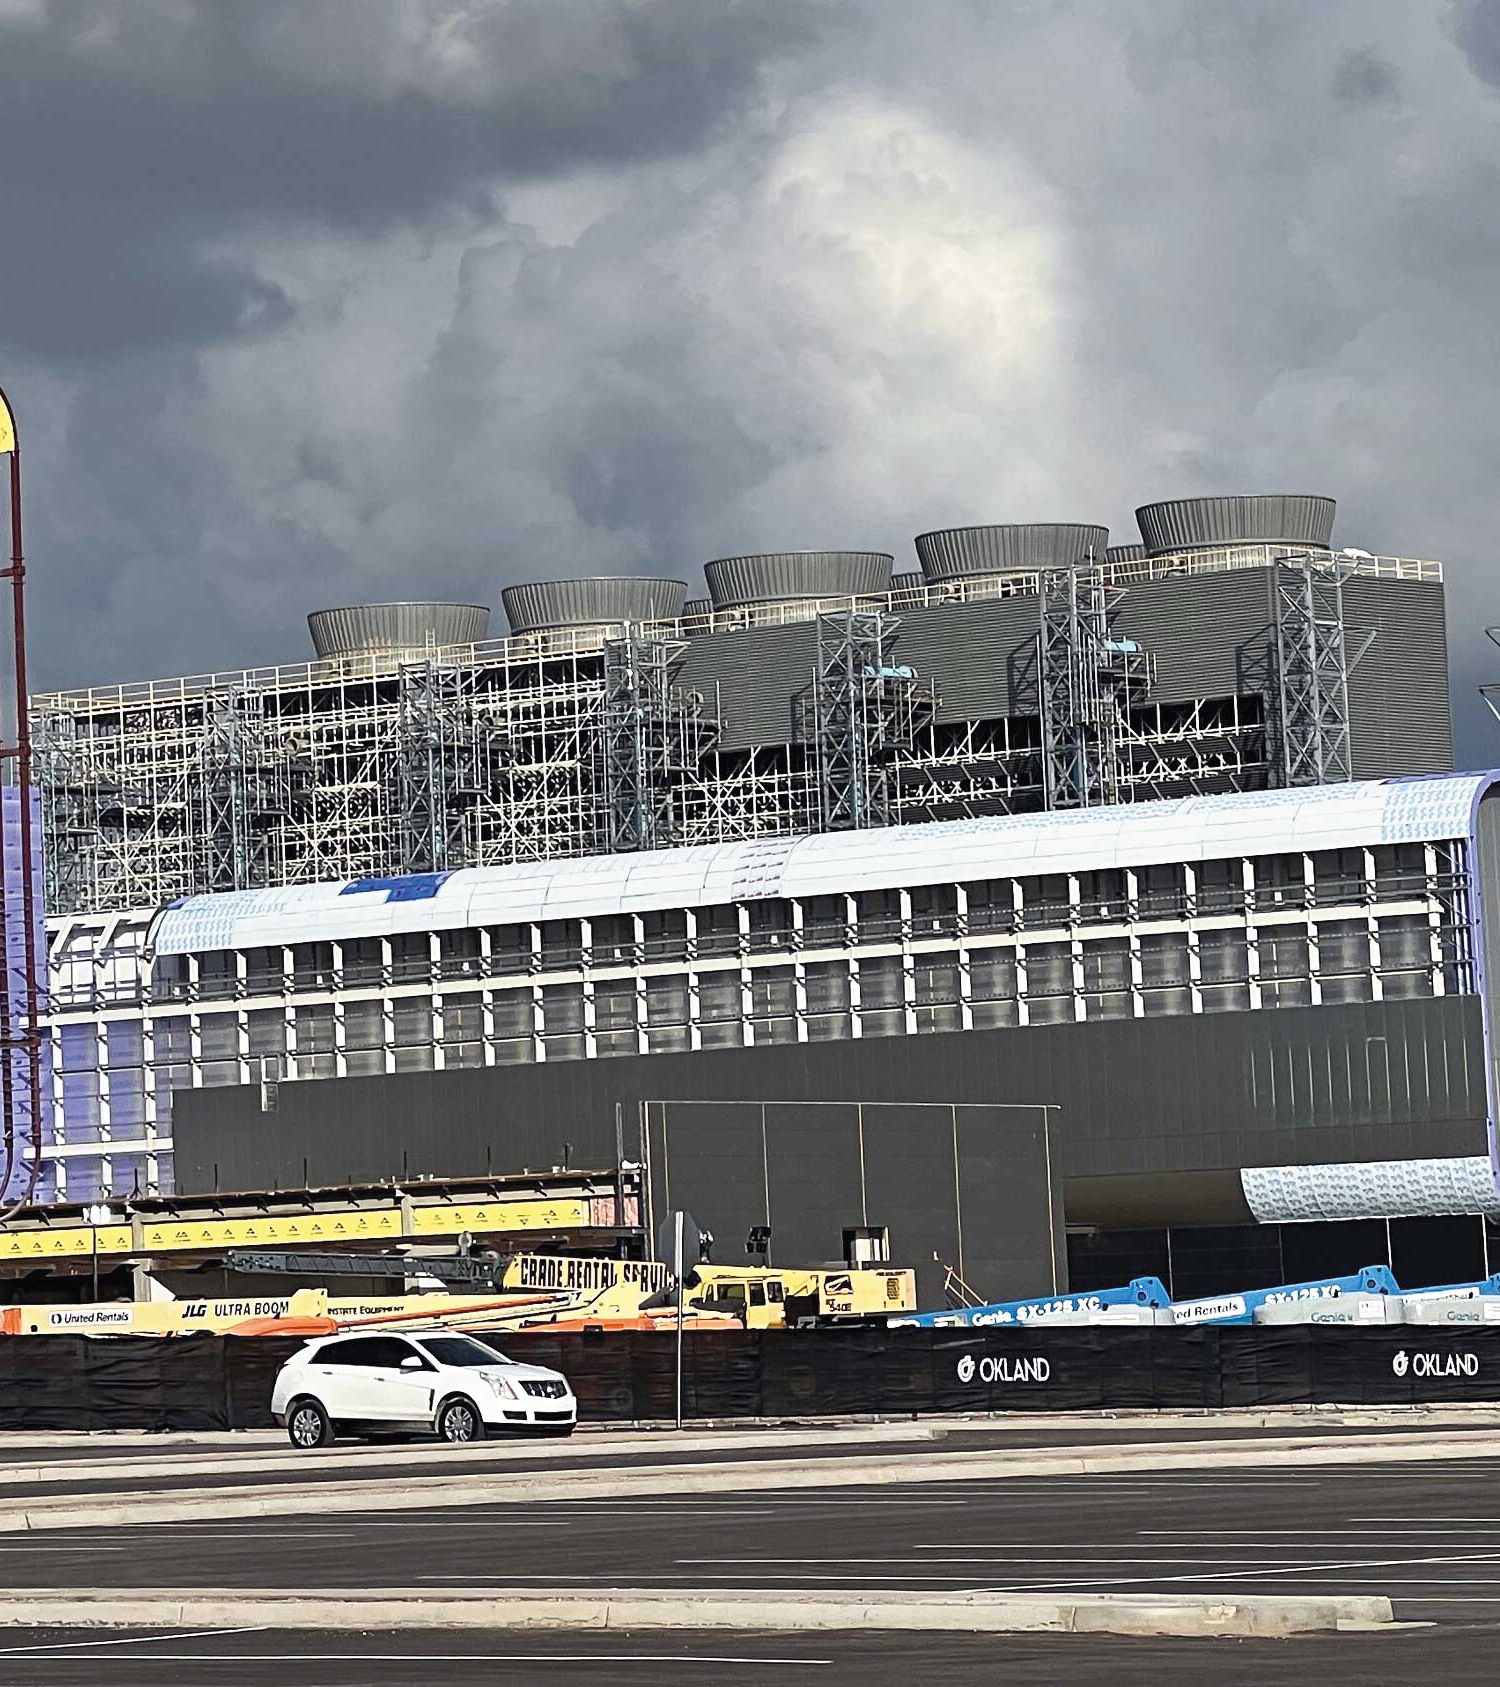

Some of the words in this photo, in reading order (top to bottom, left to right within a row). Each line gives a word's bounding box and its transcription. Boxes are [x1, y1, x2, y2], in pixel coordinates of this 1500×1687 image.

[521, 1257, 563, 1287] CRANE
[567, 1260, 617, 1289] RENTAL
[64, 1313, 94, 1323] United
[96, 1311, 129, 1322] Rentals
[182, 1304, 207, 1318] JLG
[215, 1303, 250, 1317] ULTRA
[254, 1301, 289, 1316] BOOM
[972, 1309, 1015, 1327] Genie
[1016, 1300, 1073, 1321] SX-125
[1076, 1297, 1100, 1312] XC
[1194, 1302, 1239, 1317] Rentals
[979, 1357, 1050, 1382] OKLAND
[1413, 1353, 1479, 1377] OKLAND
